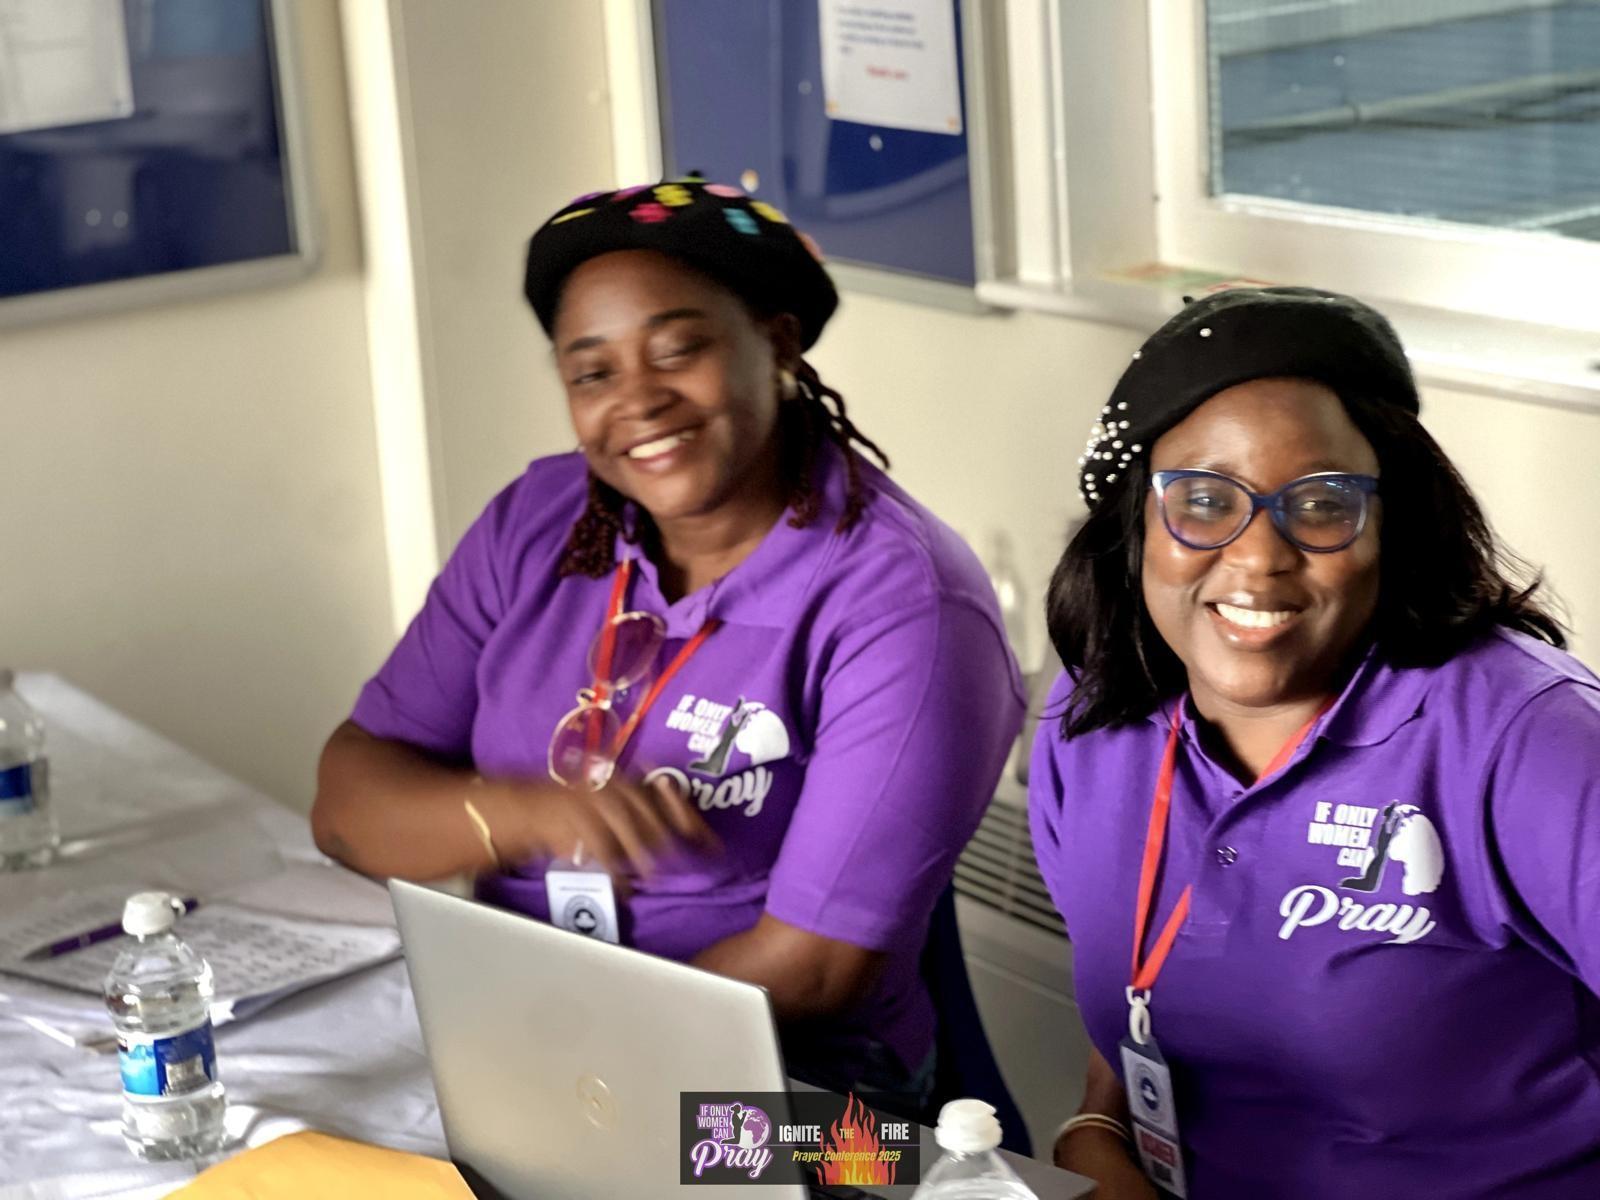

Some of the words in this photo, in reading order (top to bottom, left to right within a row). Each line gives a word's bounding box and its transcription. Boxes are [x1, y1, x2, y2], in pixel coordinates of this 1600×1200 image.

[1333, 804, 1379, 828] ONLY
[1307, 822, 1371, 849] WOMEN
[1278, 885, 1437, 944] Pray
